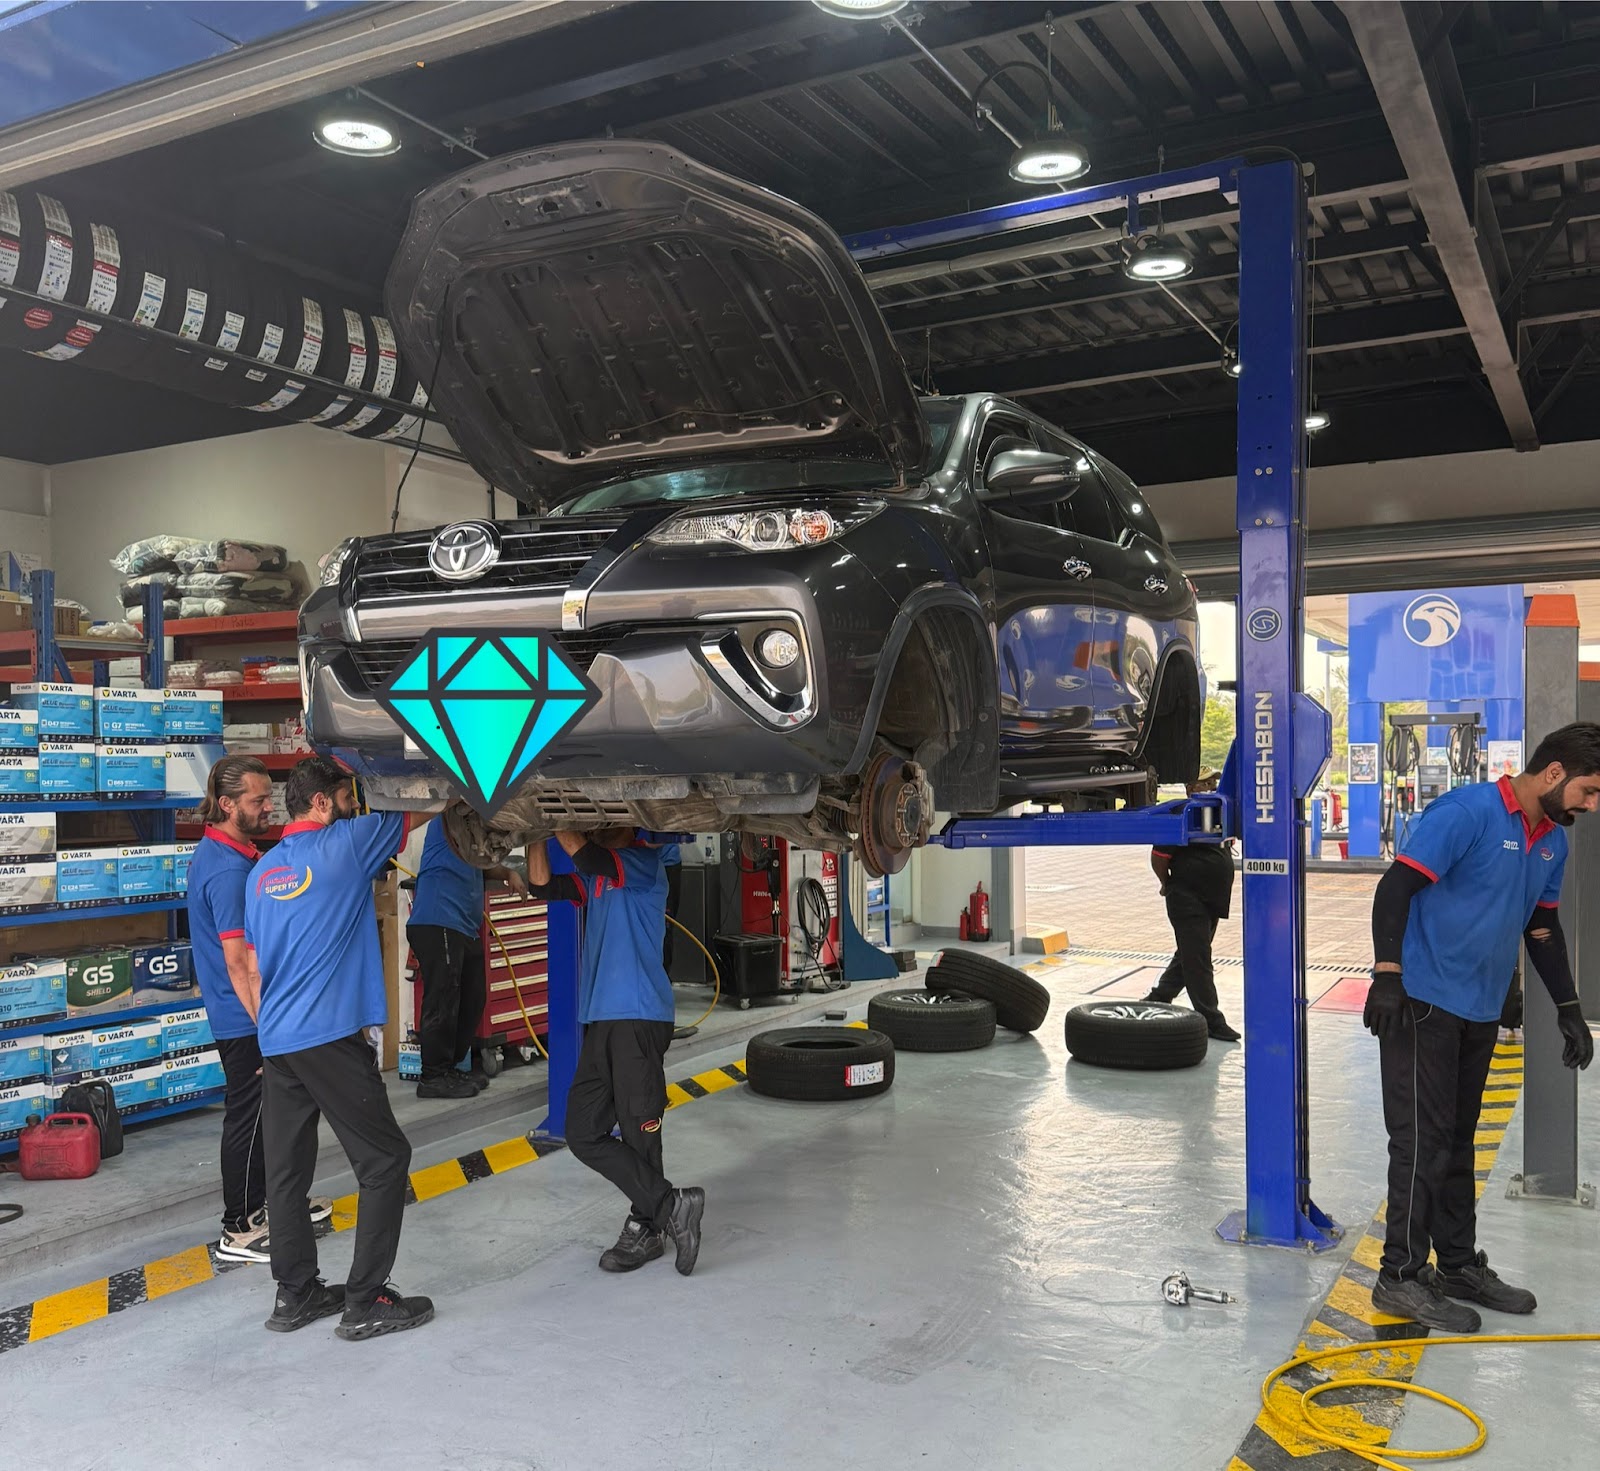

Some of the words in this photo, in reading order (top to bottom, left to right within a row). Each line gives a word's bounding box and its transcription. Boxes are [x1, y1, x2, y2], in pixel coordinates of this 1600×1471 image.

[112, 690, 137, 698] VARTA
[172, 690, 197, 698] VARTA
[0, 712, 21, 720] ARTA
[1255, 691, 1275, 824] HESHBON
[1246, 861, 1272, 872] 4000
[1272, 861, 1285, 874] kg
[265, 884, 287, 894] SUPER
[287, 881, 299, 890] FIX
[149, 954, 178, 975] GS
[6, 969, 36, 978] VARTA
[82, 964, 115, 986] GS
[86, 987, 111, 997] SHIELD
[175, 1012, 200, 1022] VARTA
[66, 1034, 85, 1042] VARTA
[108, 1031, 134, 1041] VARTA
[0, 1040, 18, 1049] RTA
[174, 1056, 200, 1067] VARTA
[107, 1073, 134, 1084] VARTA
[0, 1090, 20, 1100] ARTA
